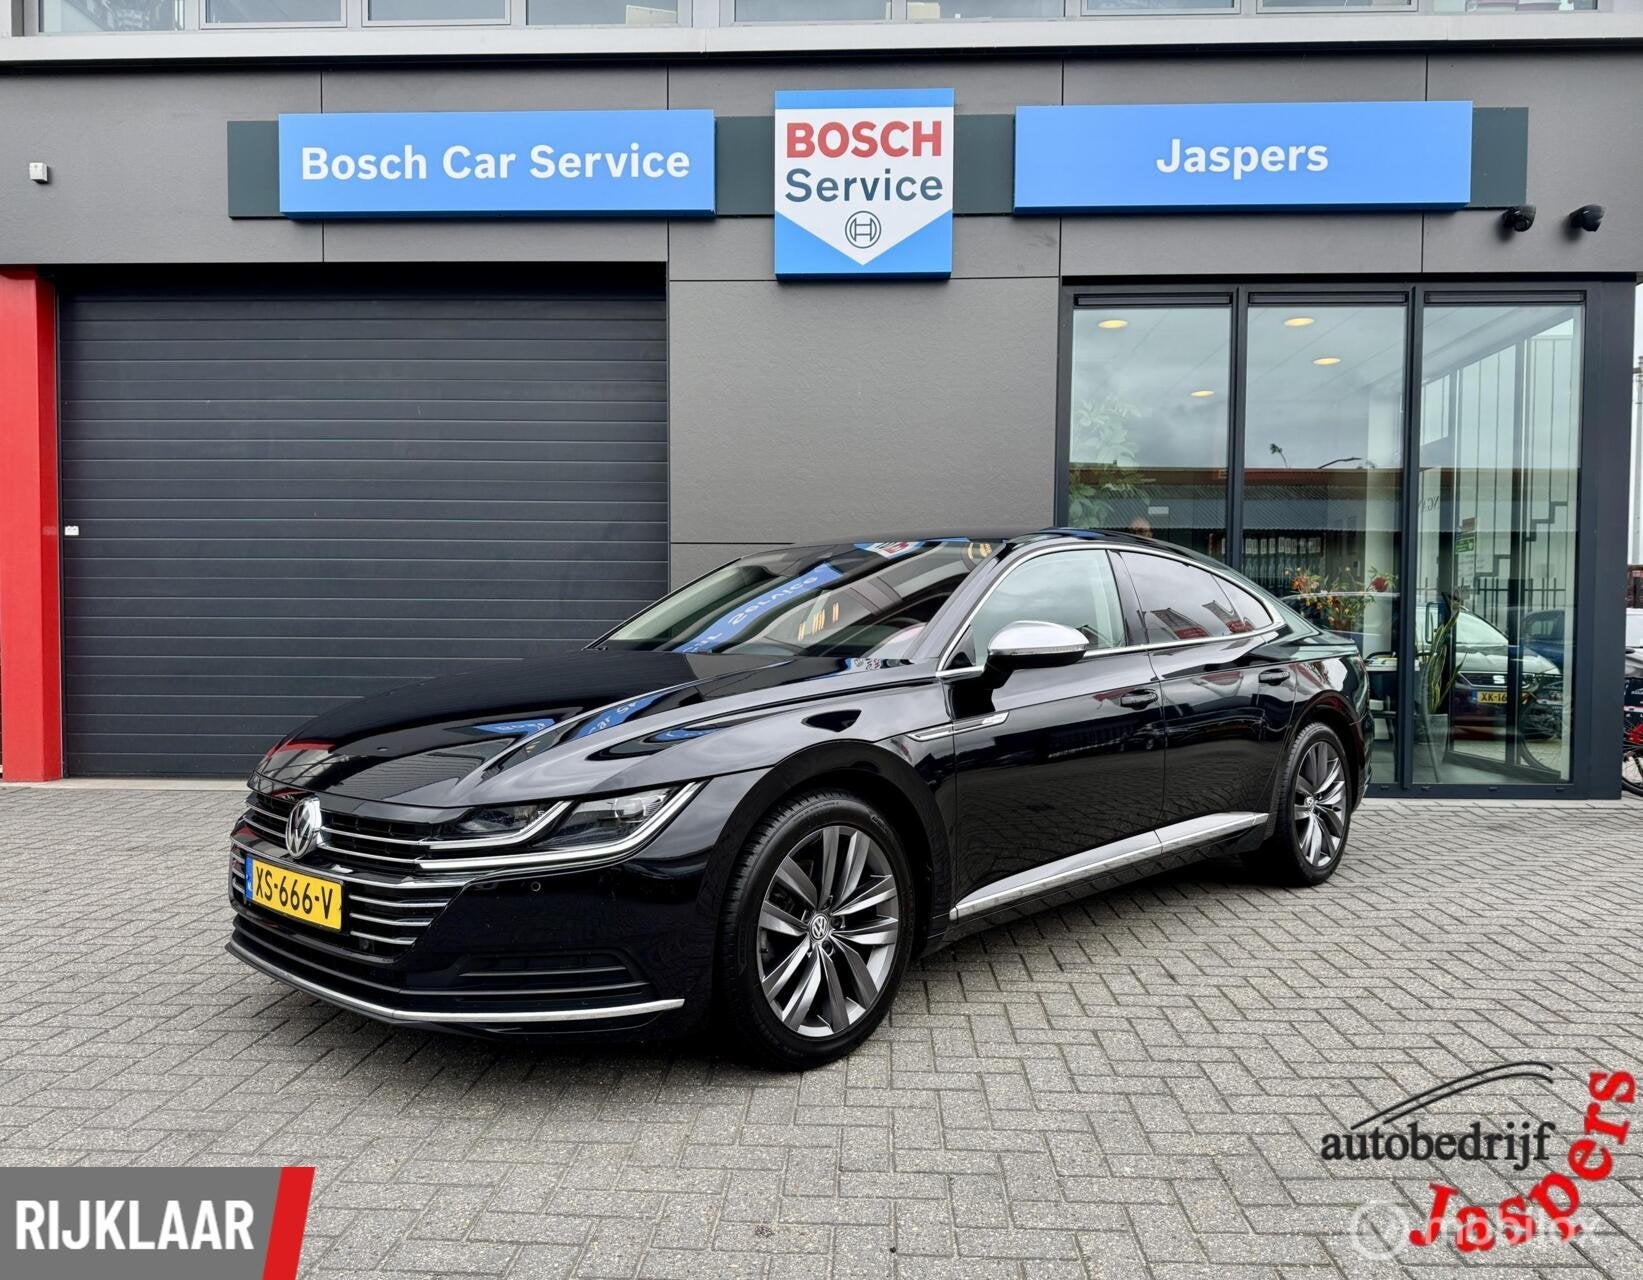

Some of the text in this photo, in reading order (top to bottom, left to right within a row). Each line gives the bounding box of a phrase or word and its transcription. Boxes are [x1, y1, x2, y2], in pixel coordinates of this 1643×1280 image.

[786, 121, 942, 158] BOSCH
[302, 142, 691, 180] Bosch Car Service
[1156, 138, 1329, 180] Jaspers
[785, 168, 943, 203] Service
[255, 866, 333, 920] XS-666-V
